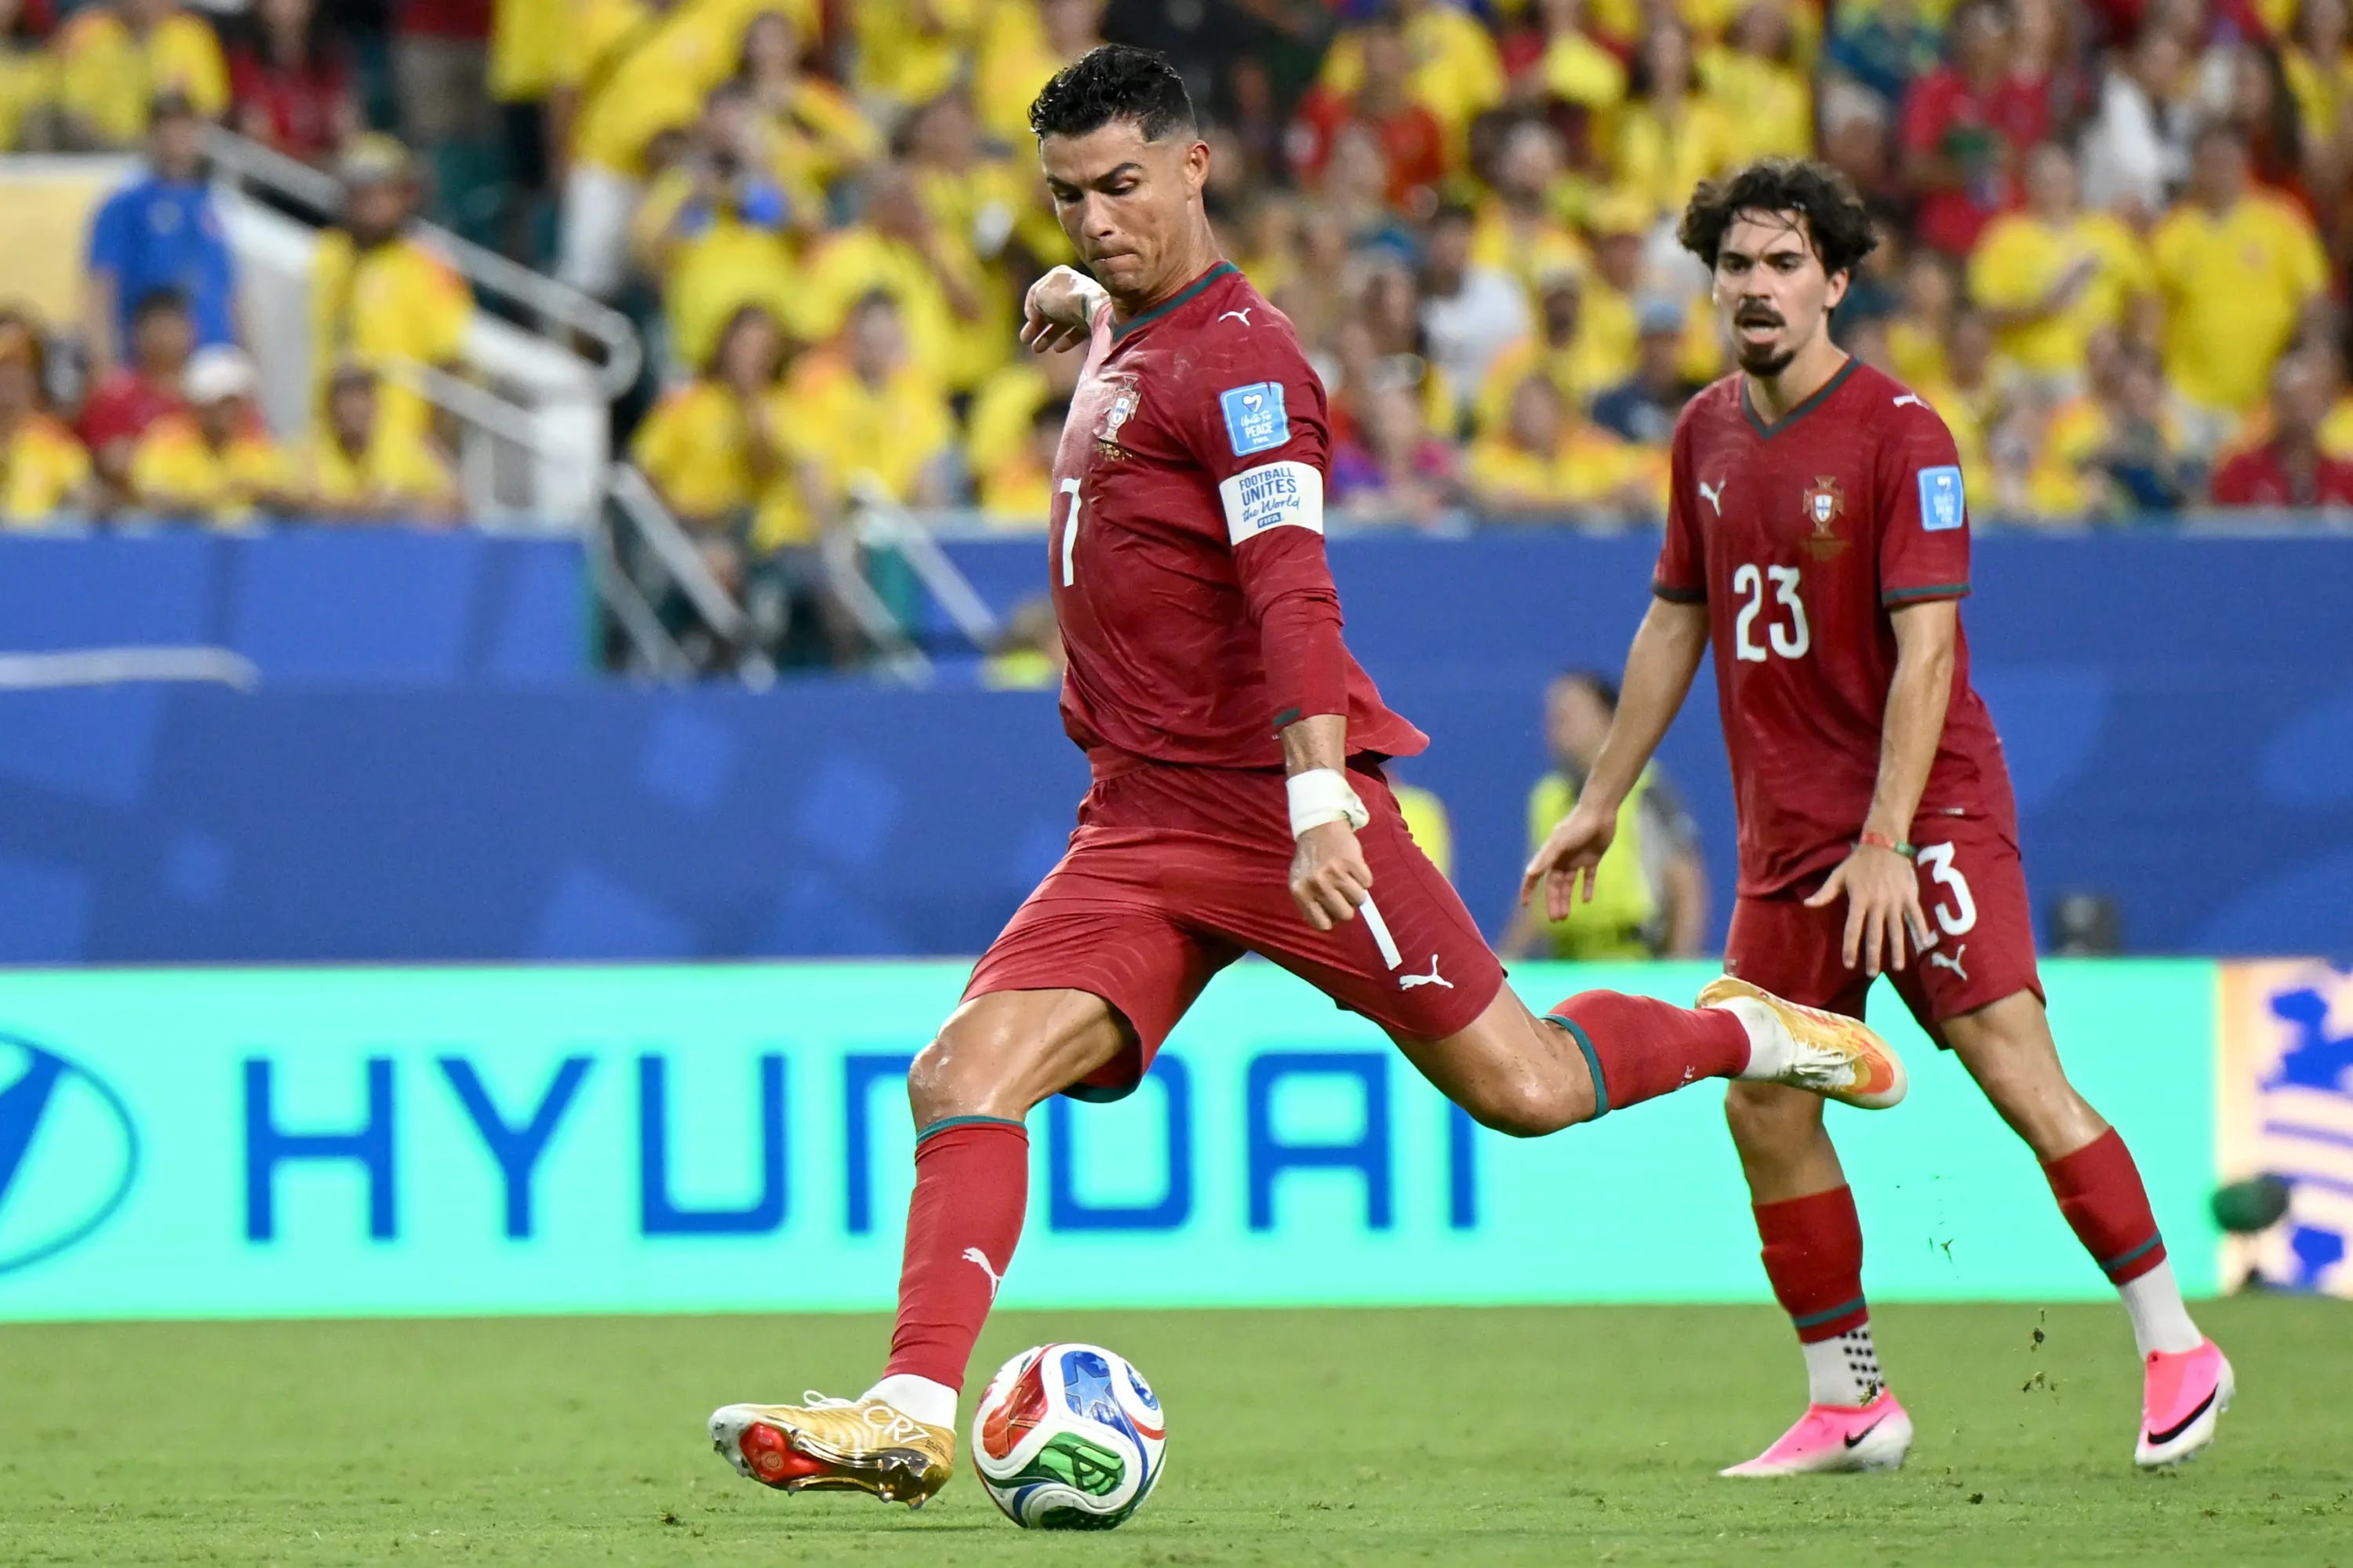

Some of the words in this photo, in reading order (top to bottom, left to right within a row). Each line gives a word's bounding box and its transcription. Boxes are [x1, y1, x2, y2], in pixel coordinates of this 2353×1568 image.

[1244, 421, 1274, 438] PEACE
[1239, 467, 1295, 492] FOOTBALL
[1242, 478, 1297, 506] UNITES
[1242, 507, 1260, 523] the
[1260, 494, 1301, 514] World
[1258, 512, 1281, 527] FIFA
[1060, 477, 1082, 588] 7
[1733, 562, 1810, 663] 23
[863, 1404, 933, 1444] CR7
